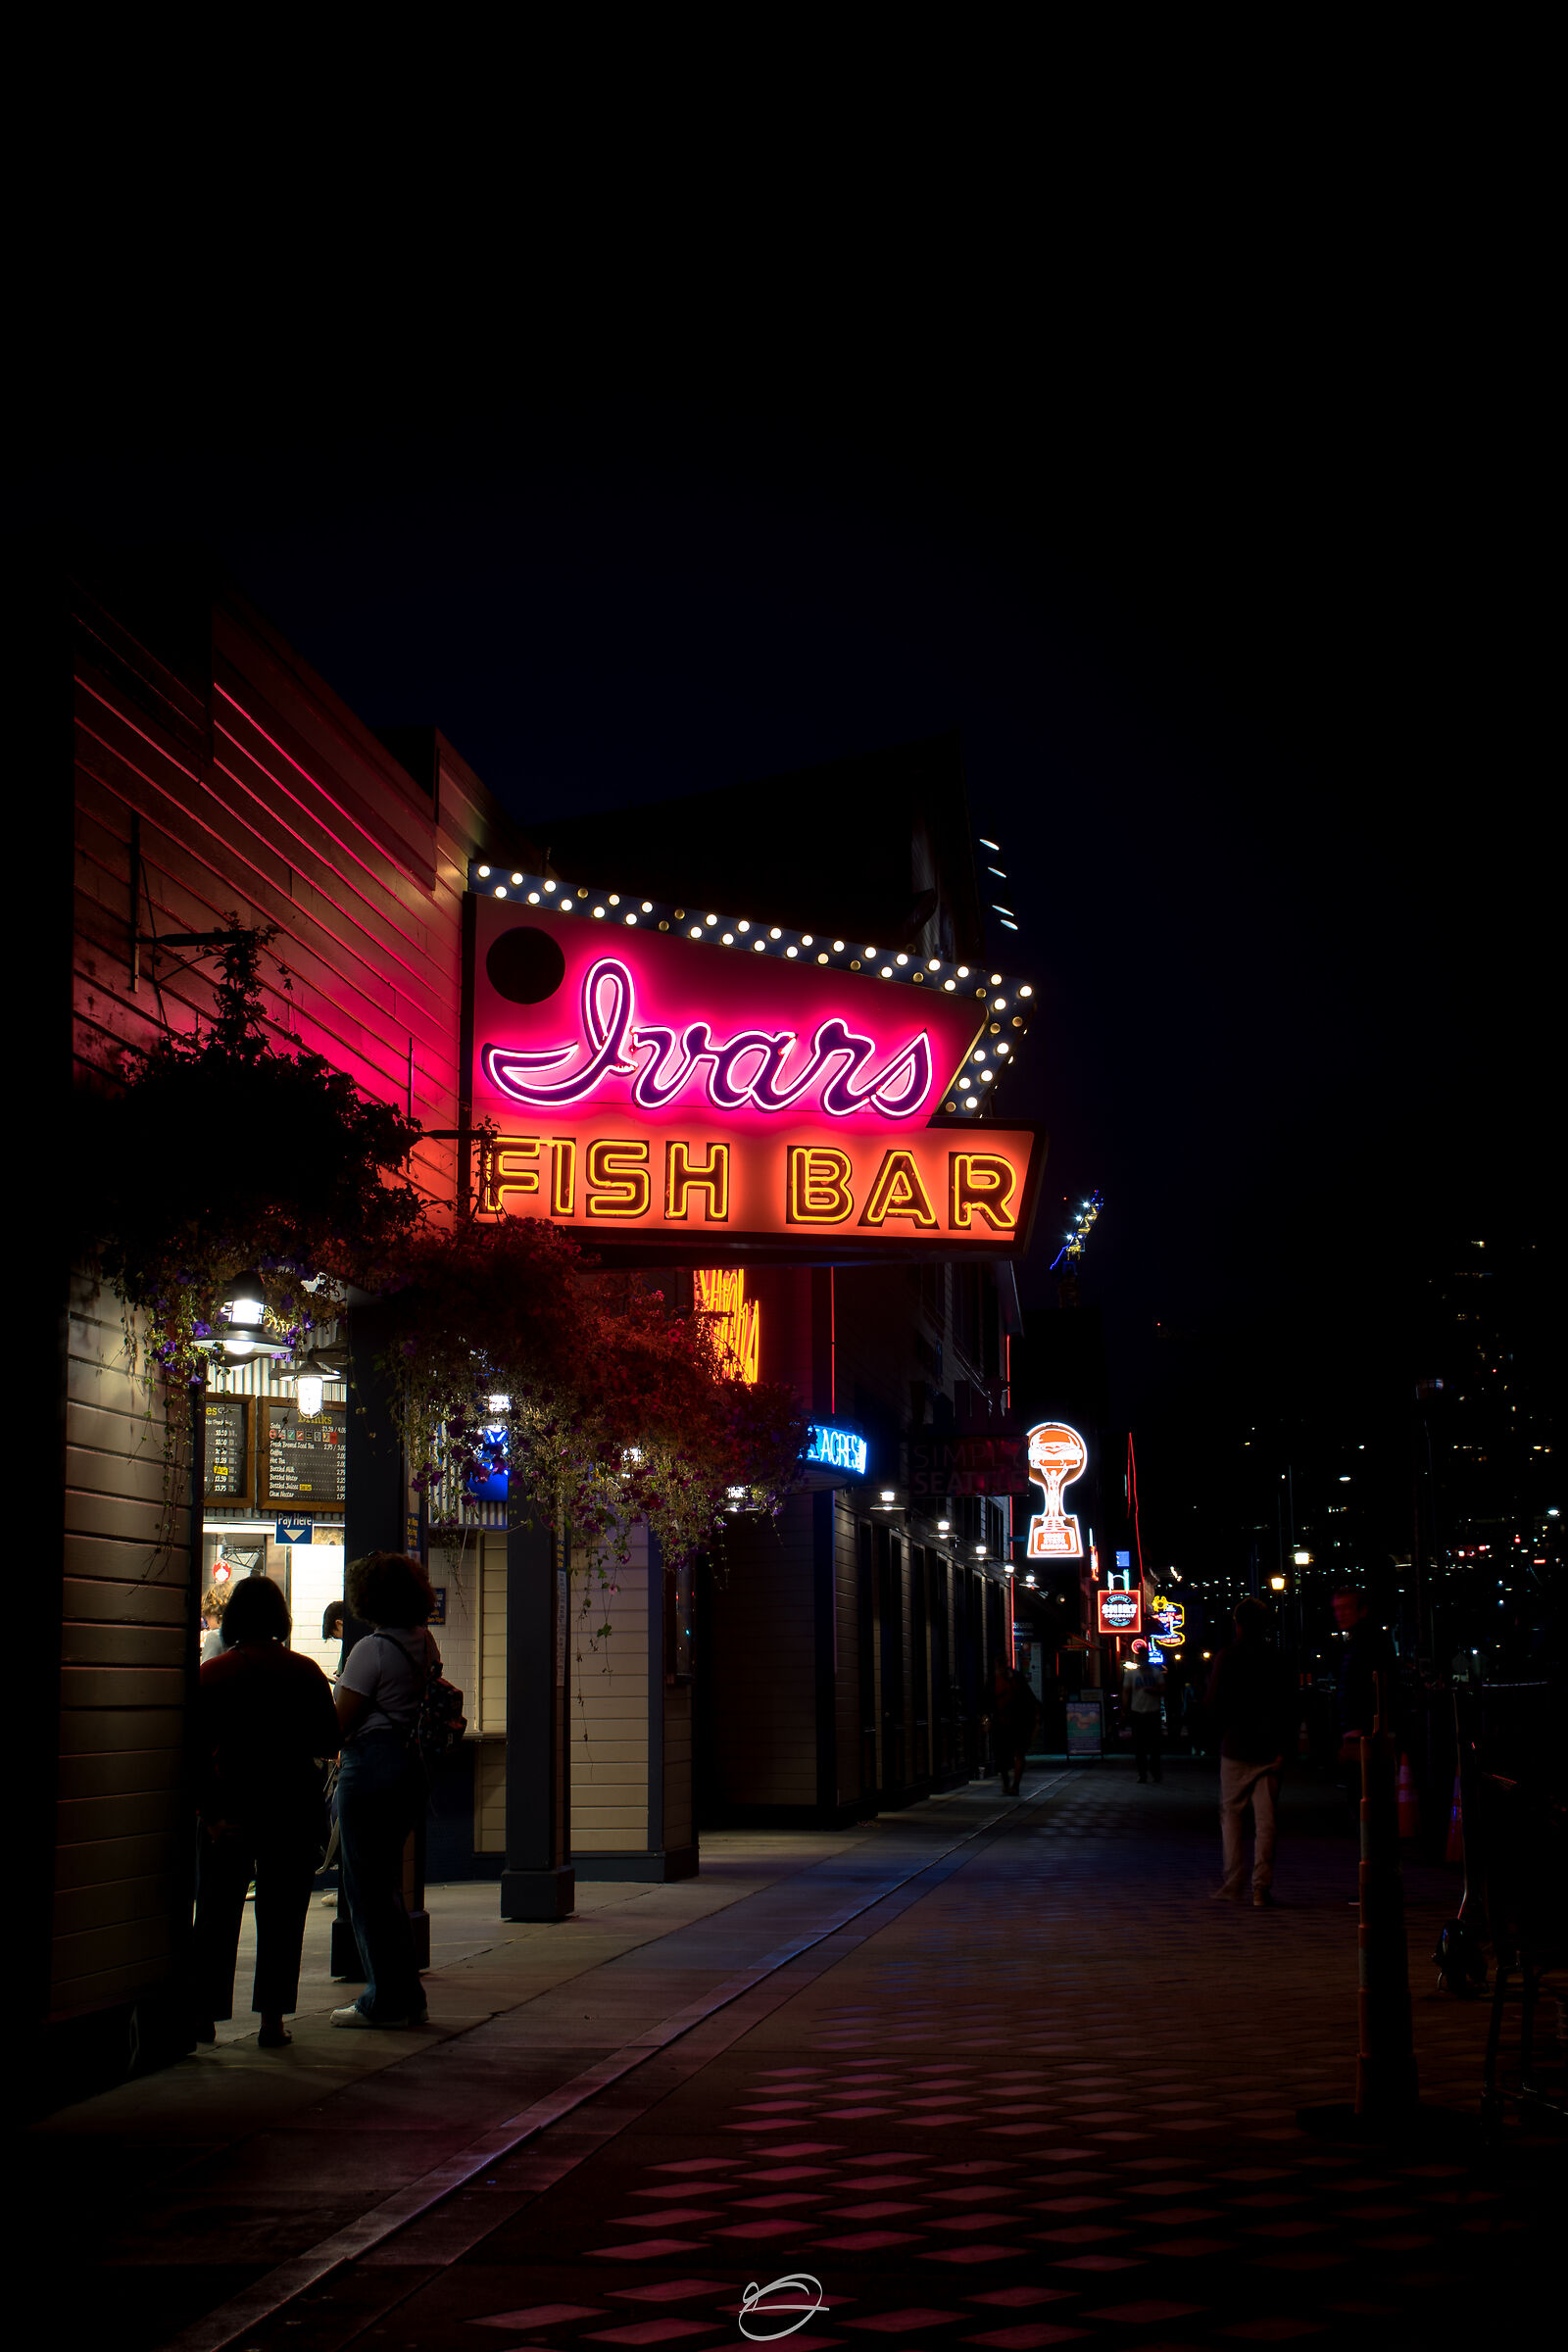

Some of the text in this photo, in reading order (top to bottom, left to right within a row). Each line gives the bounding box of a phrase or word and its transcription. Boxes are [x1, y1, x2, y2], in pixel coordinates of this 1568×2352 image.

[480, 956, 934, 1120] Ivars
[478, 1134, 1019, 1231] FISH BAR
[820, 1428, 858, 1469] ACRES
[912, 1443, 1021, 1468] SIMPLY
[912, 1470, 1027, 1495] SEATTLE
[278, 1514, 312, 1528] Pay Here
[1102, 1603, 1138, 1614] SHIRT
